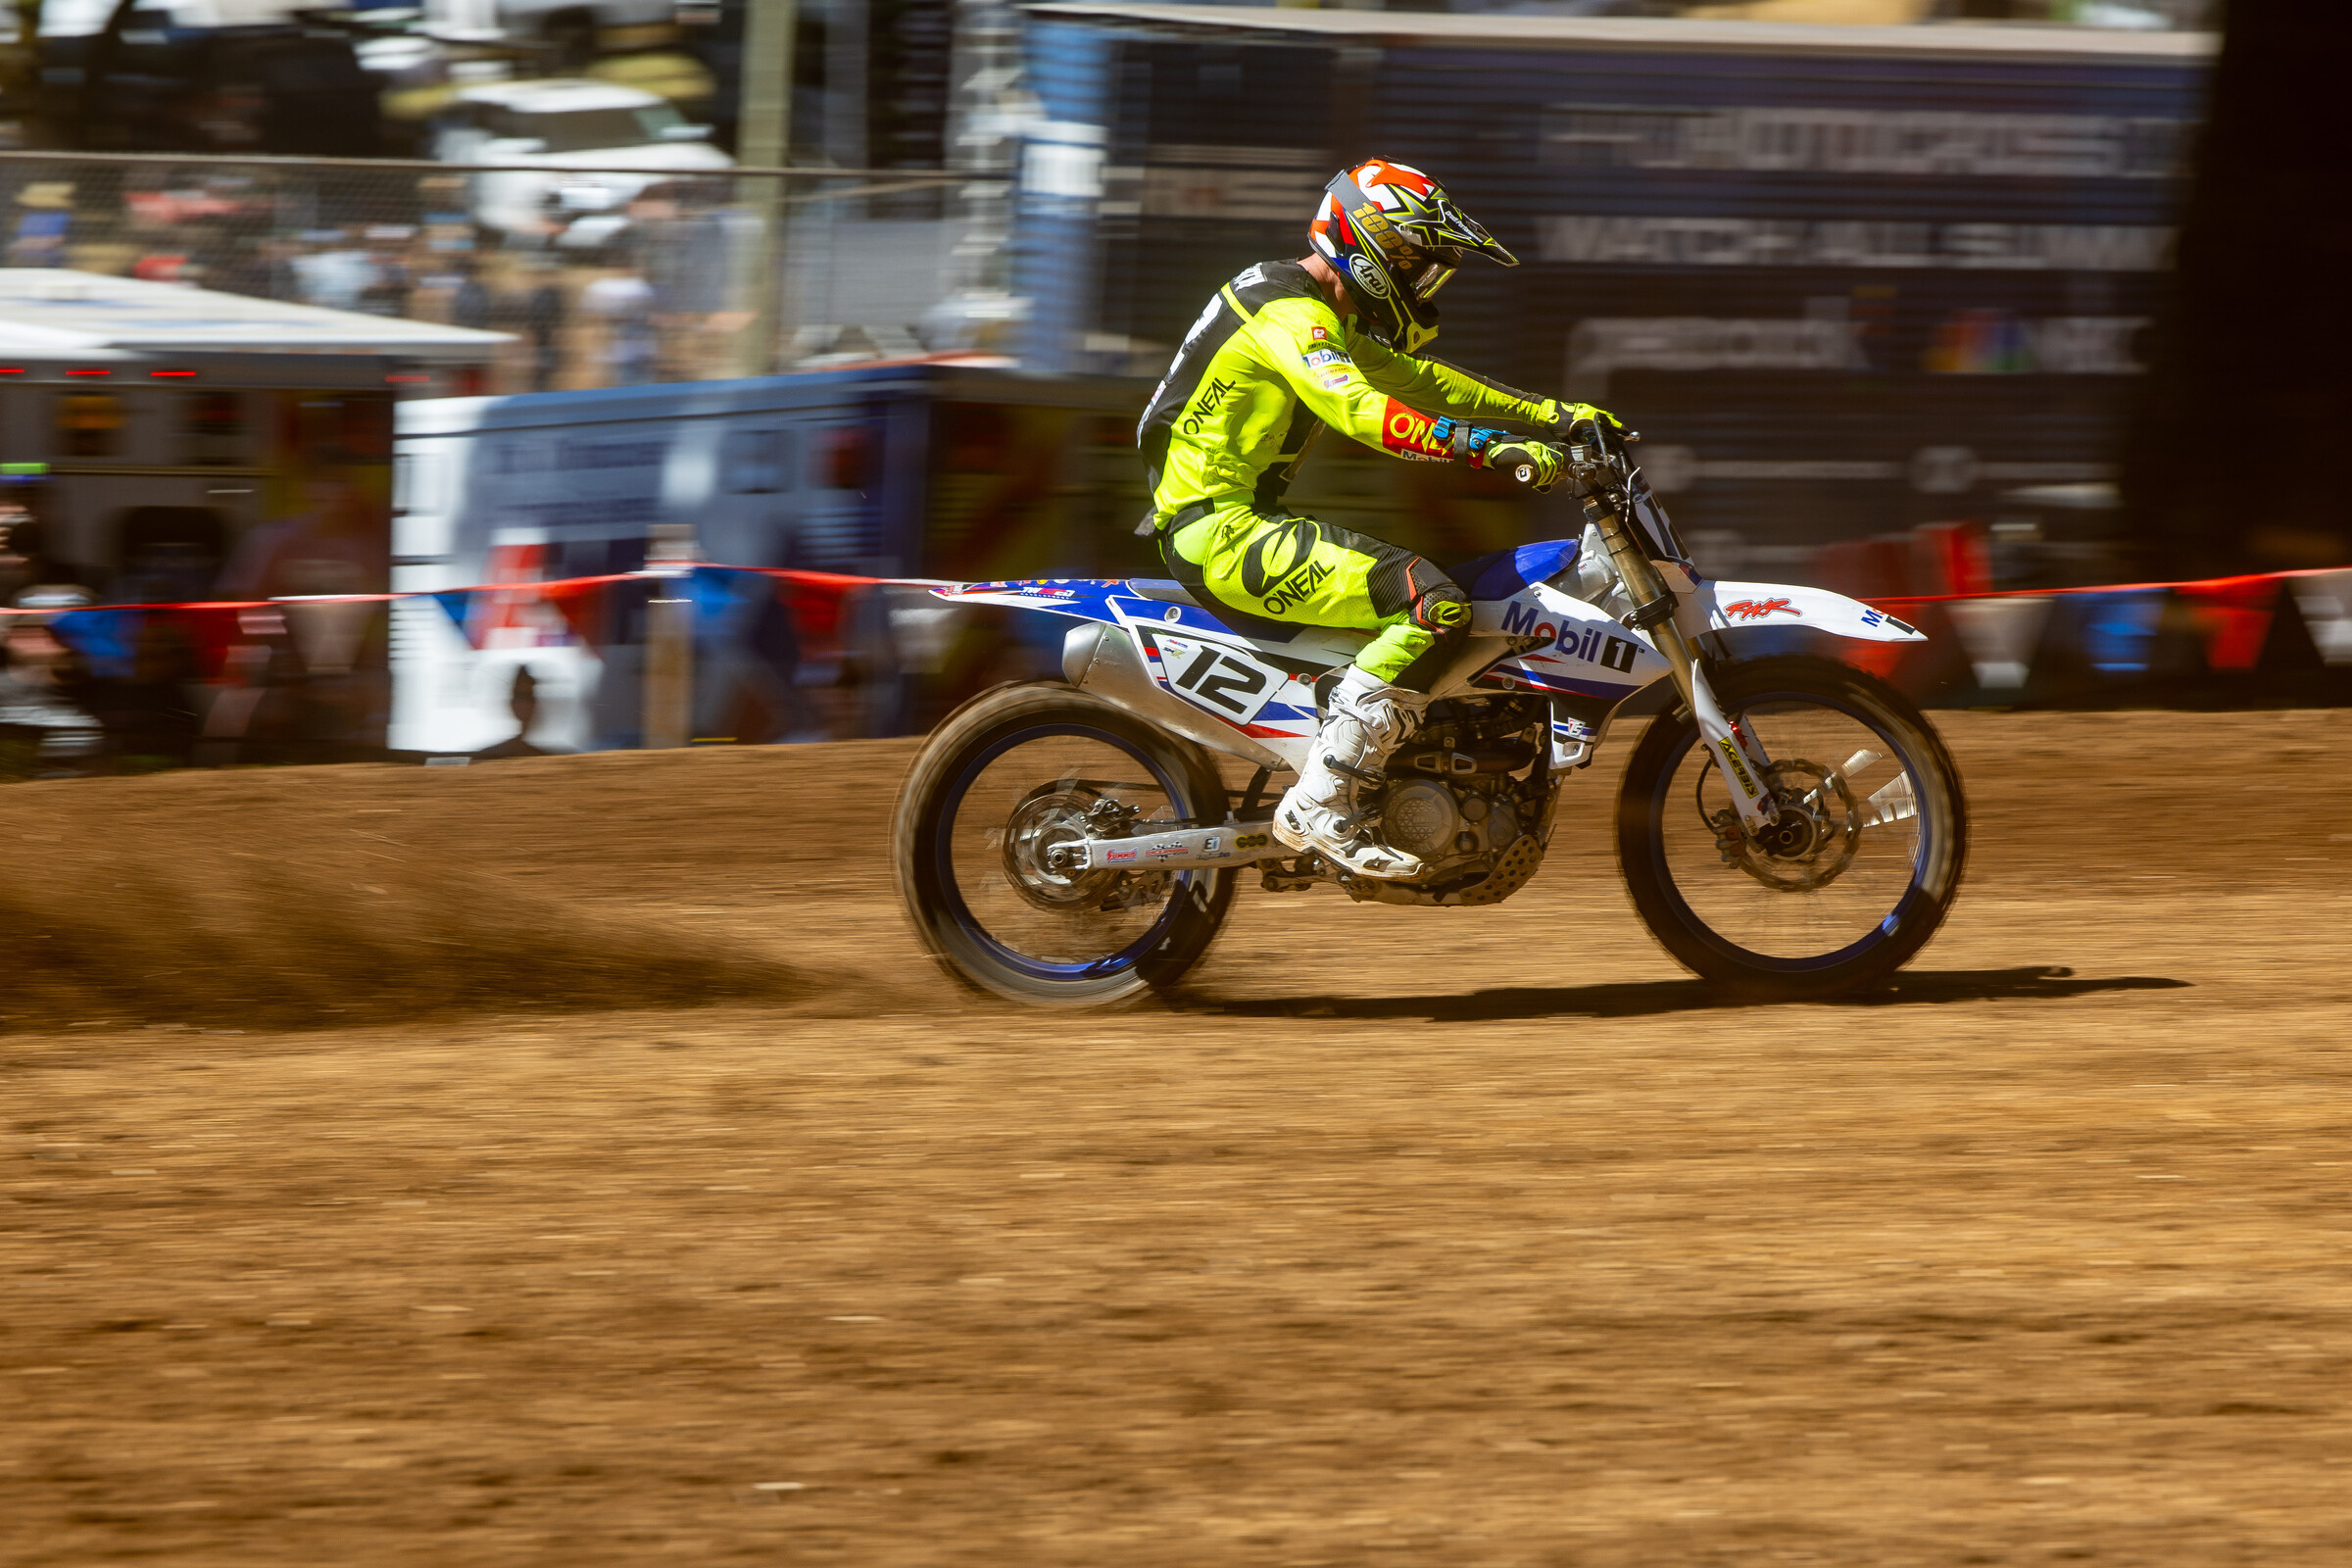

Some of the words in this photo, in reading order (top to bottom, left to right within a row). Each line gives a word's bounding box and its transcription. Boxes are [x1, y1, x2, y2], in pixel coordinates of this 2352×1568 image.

[1352, 202, 1420, 270] 100%
[1353, 261, 1386, 293] Arai
[1500, 600, 1602, 663] Mobil
[1175, 645, 1267, 714] 12
